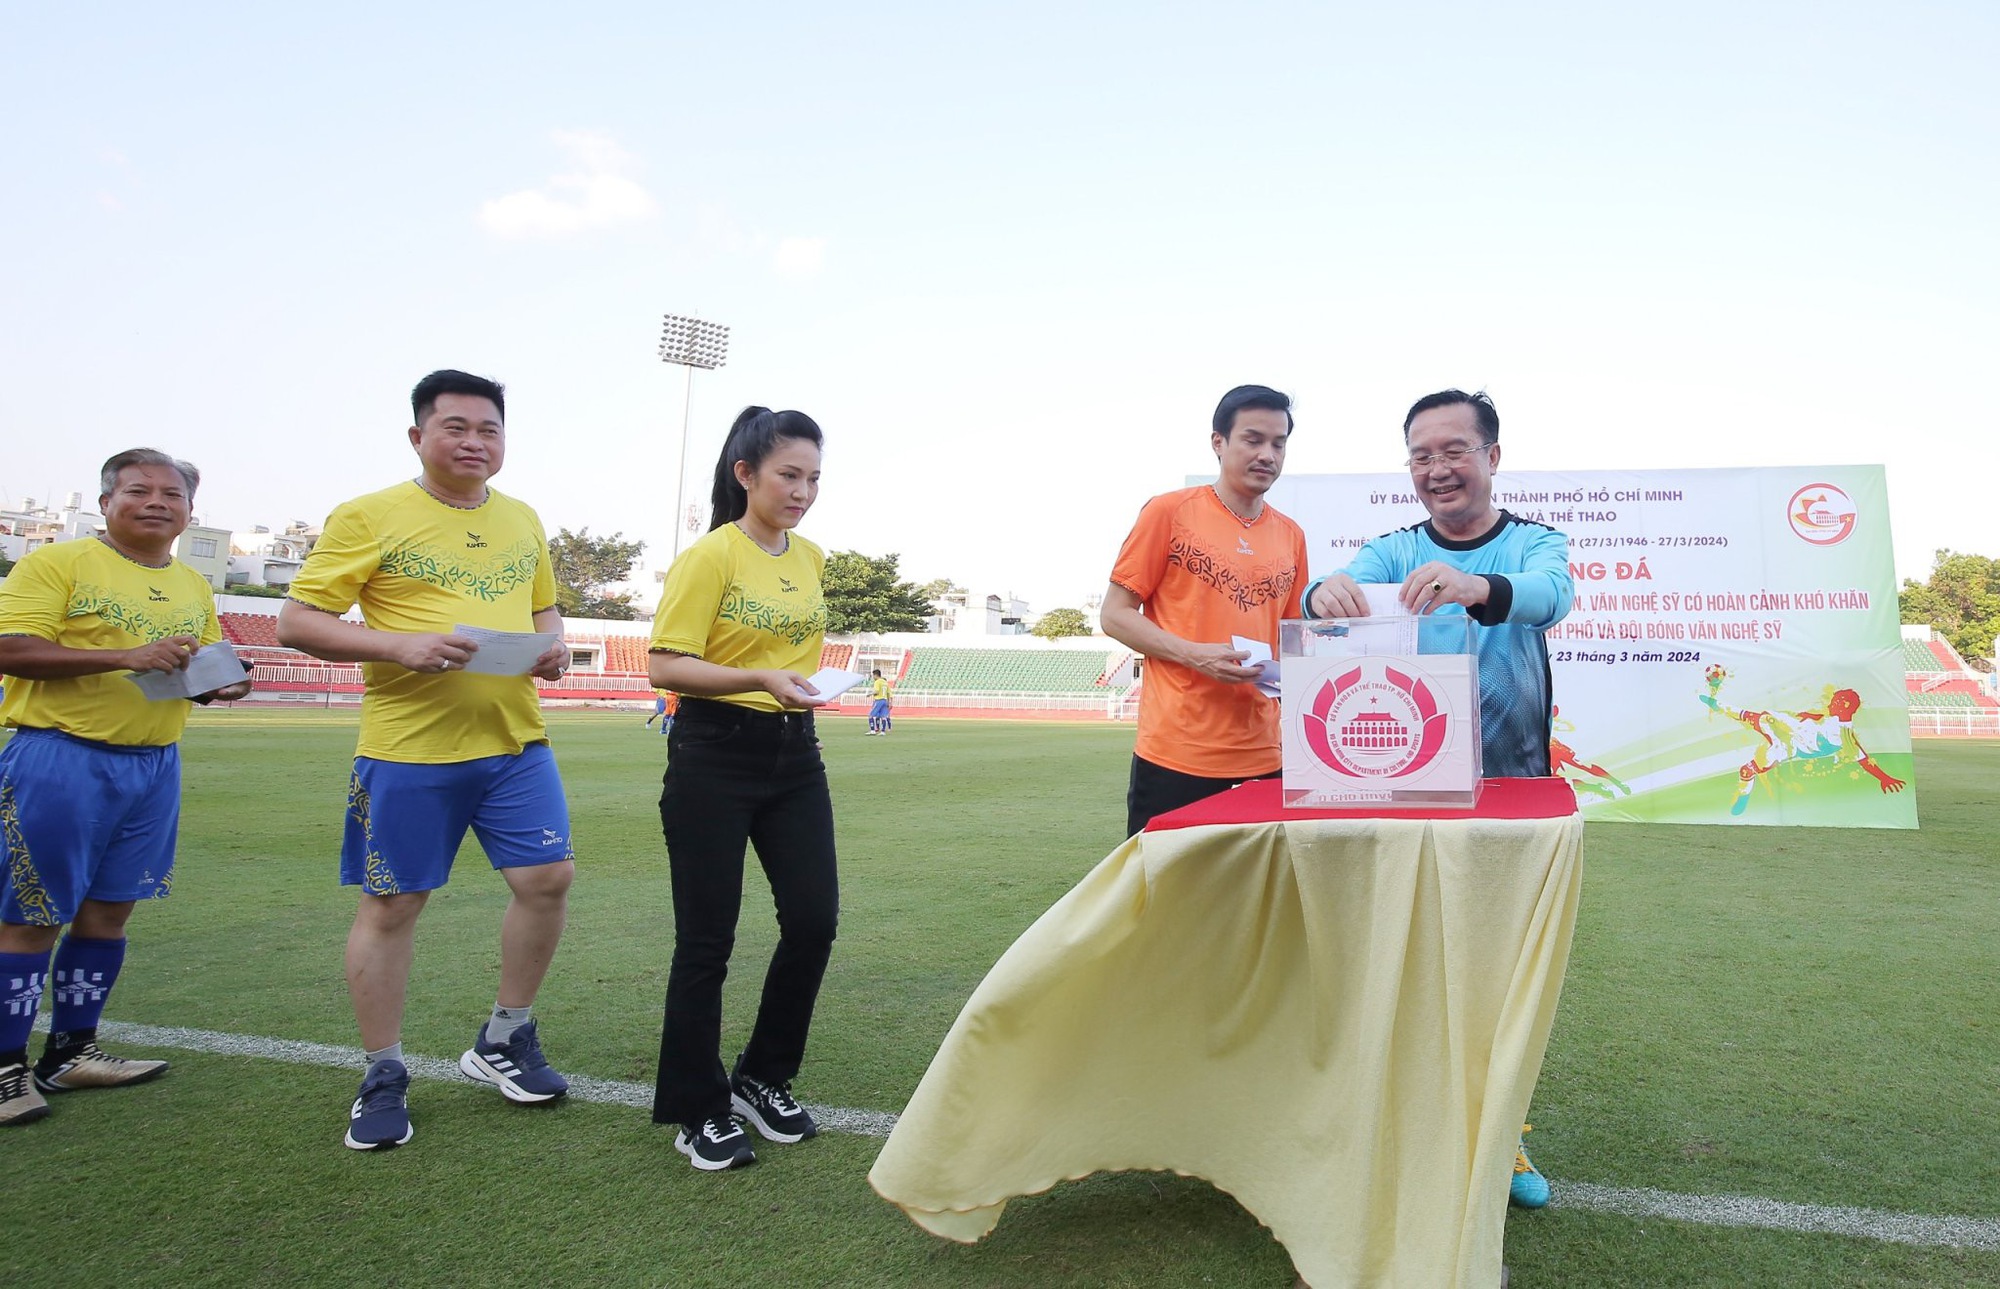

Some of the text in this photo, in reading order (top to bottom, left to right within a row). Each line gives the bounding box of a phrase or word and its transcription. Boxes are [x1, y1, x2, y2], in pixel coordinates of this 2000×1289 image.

[1370, 490, 1419, 504] ỦY BAN
[1502, 489, 1549, 503] THÀNH
[1554, 487, 1584, 502] PHỐ
[1588, 487, 1610, 502] HỒ
[1614, 488, 1641, 502] CHÍ
[1645, 490, 1683, 501] MINH
[1526, 508, 1545, 522] VÀ
[1549, 506, 1574, 522] THỂ
[1578, 511, 1617, 522] THAO
[1579, 537, 1648, 549] (27/3/1946
[1658, 536, 1728, 548] 27/3/2024)
[1615, 556, 1653, 580] ĐÁ
[1590, 592, 1617, 611] VĂN
[1622, 591, 1659, 615] NGHỆ
[1662, 592, 1680, 611] SỸ
[1684, 591, 1702, 611] CÓ
[1707, 591, 1746, 611] HOÀN
[1750, 589, 1790, 611] CẢNH
[1794, 590, 1824, 610] KHÓ
[1828, 589, 1869, 609] KHĂN
[1566, 619, 1595, 639] PHỐ
[1597, 619, 1616, 640] VÀ
[1619, 620, 1643, 642] ĐỘI
[1647, 620, 1684, 640] BÓNG
[1688, 620, 1717, 640] VĂN
[1721, 619, 1760, 643] NGHỆ
[1764, 619, 1782, 640] SỸ
[1556, 651, 1572, 662] 23
[1577, 651, 1616, 665] tháng
[1620, 651, 1628, 662] 3
[1632, 651, 1662, 662] năm
[1667, 651, 1700, 662] 2024
